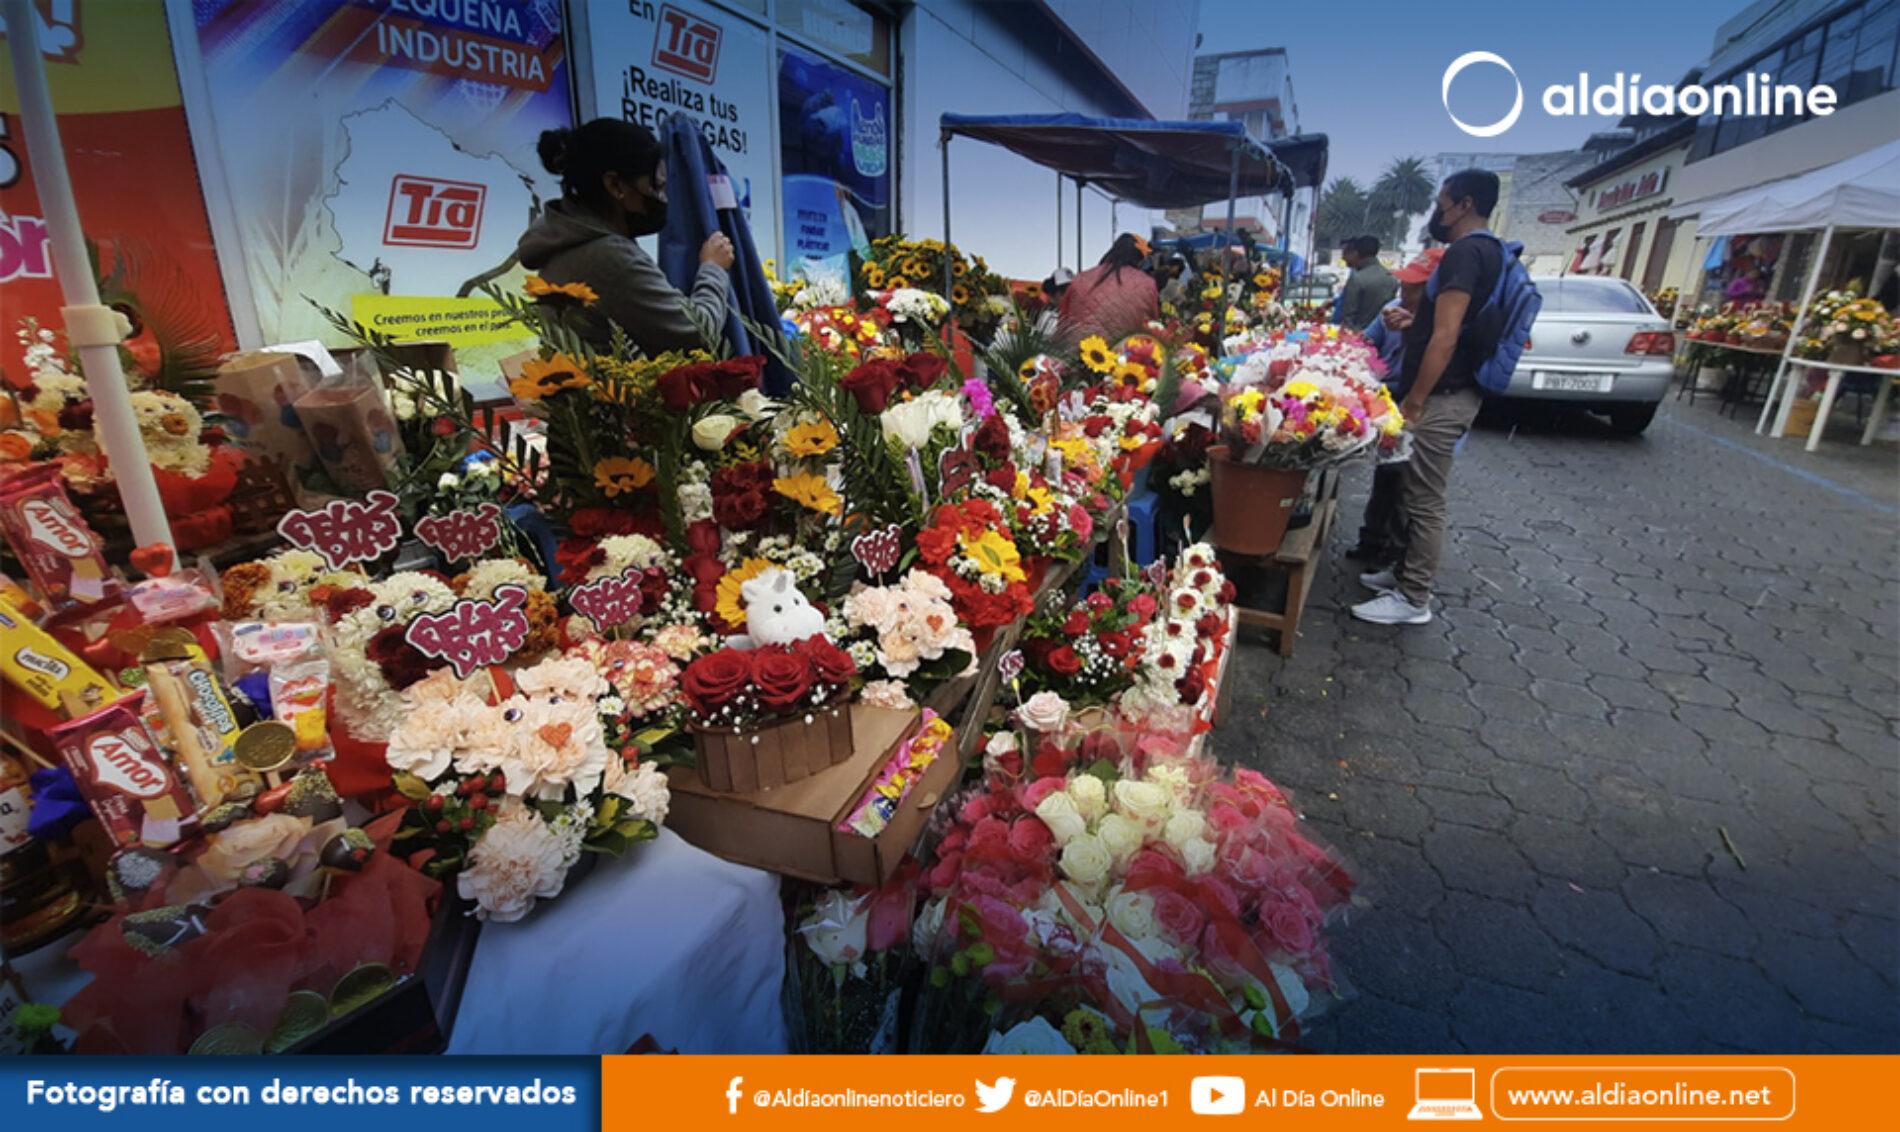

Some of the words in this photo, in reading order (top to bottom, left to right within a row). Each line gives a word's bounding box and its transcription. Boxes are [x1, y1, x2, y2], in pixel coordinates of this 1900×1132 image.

[628, 0, 654, 22] En
[378, 22, 545, 83] INDUSTRIA
[623, 65, 705, 113] ¡Realiza
[709, 93, 738, 123] tus
[373, 313, 427, 326] Creemos
[429, 312, 442, 321] en
[445, 309, 490, 321] nuestros
[416, 323, 462, 337] creemos
[464, 323, 477, 332] en
[479, 321, 488, 331] el
[24, 507, 88, 550] Amor
[93, 743, 164, 789] Amor
